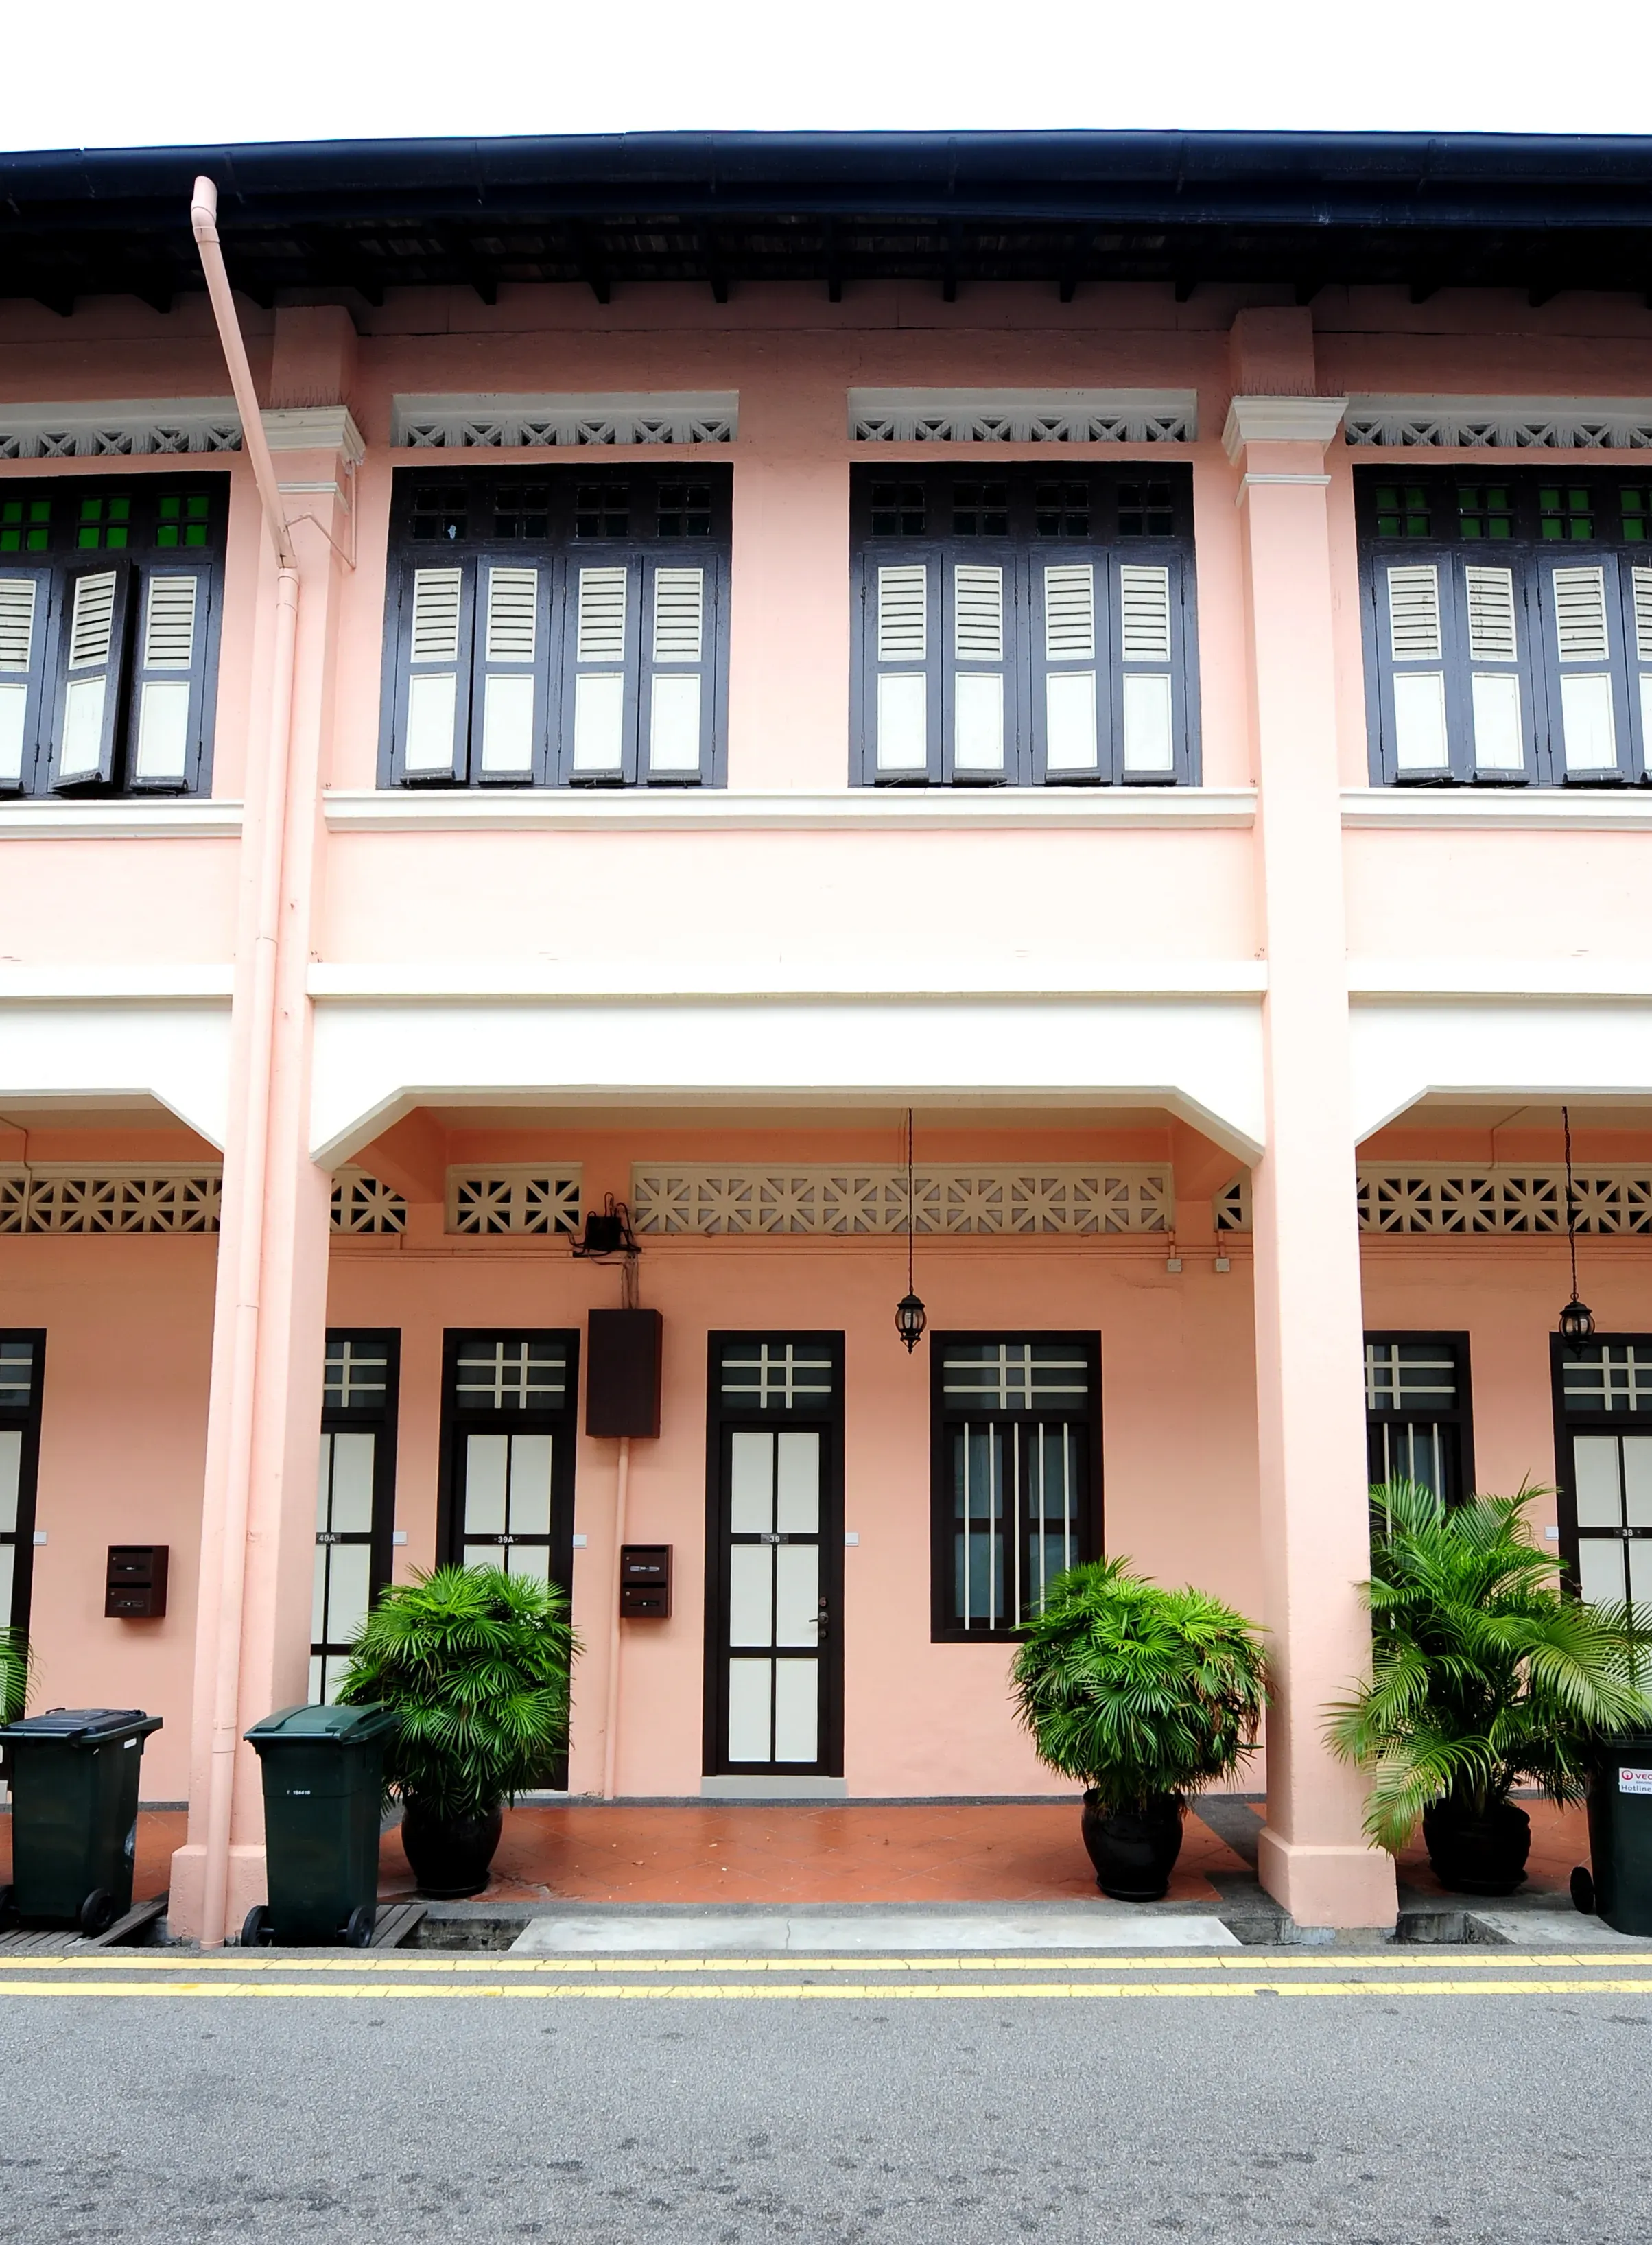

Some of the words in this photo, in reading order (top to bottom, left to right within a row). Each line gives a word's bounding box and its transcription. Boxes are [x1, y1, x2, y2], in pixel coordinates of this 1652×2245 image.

[497, 1536, 514, 1544] 39A
[769, 1535, 780, 1543] 39
[1621, 1784, 1652, 1792] Hotline
